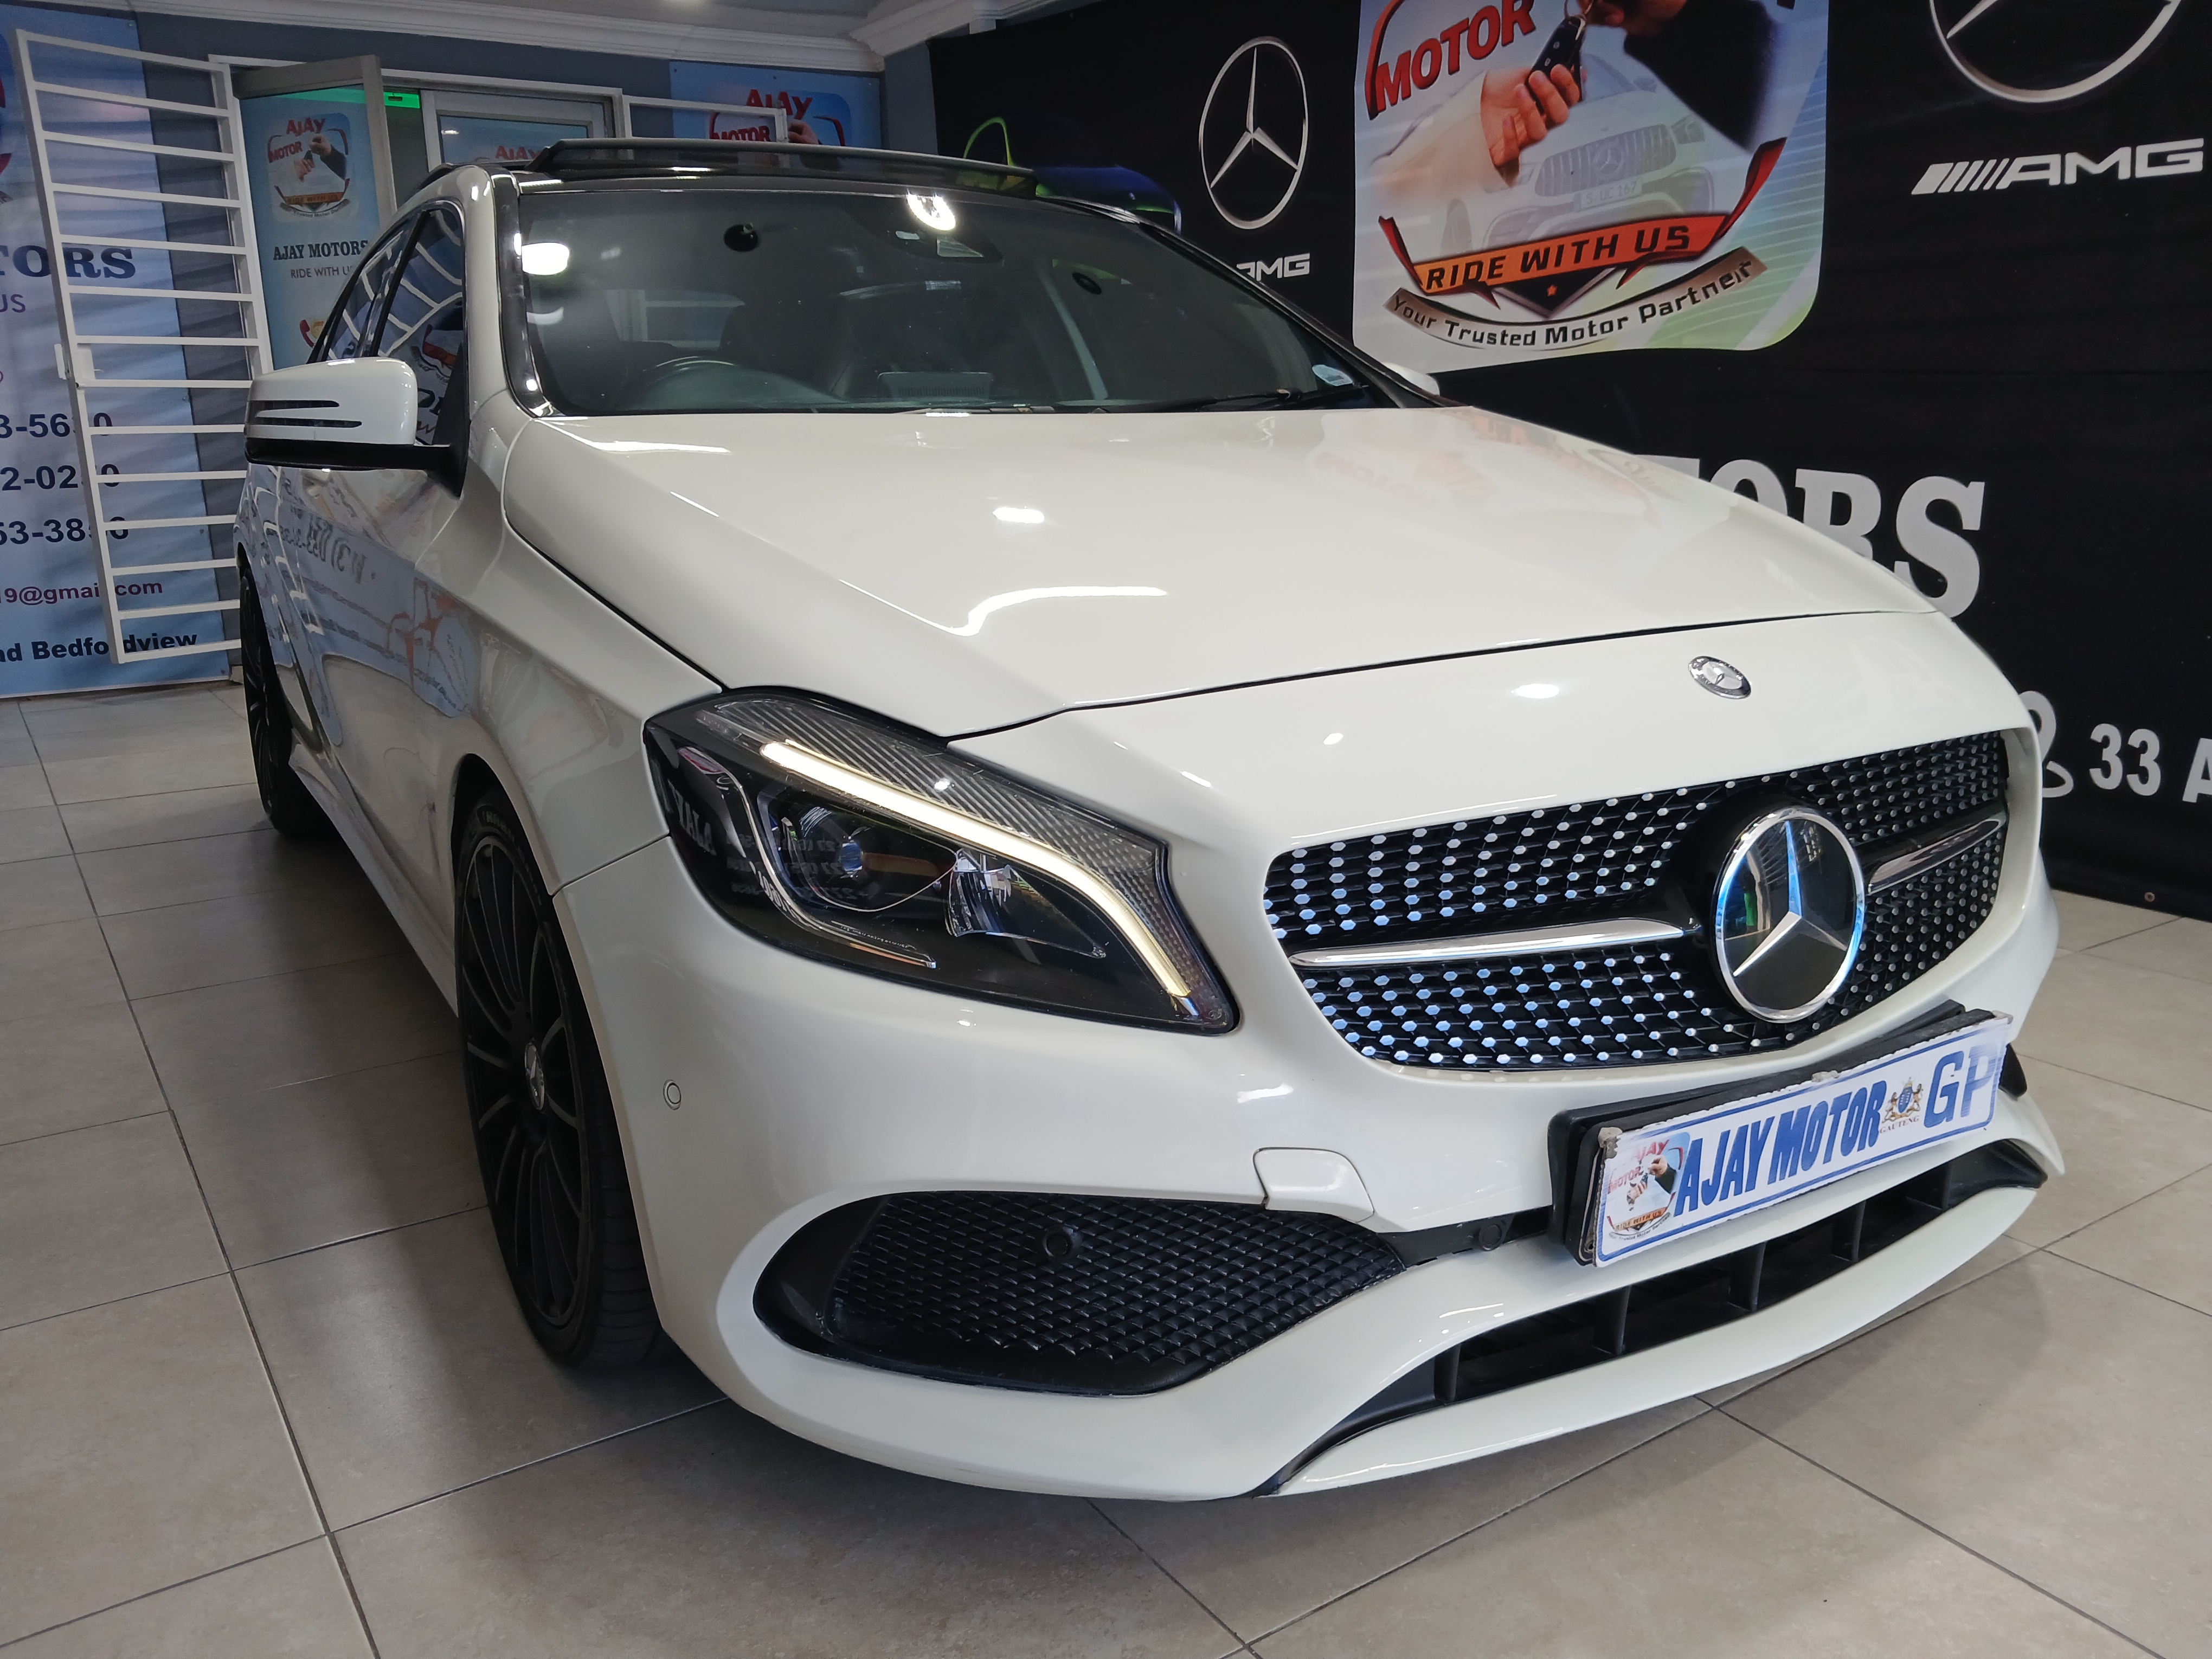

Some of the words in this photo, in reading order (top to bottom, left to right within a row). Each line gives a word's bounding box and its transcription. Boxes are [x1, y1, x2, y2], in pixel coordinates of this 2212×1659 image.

[1375, 0, 1536, 113] MOTOR
[287, 117, 326, 137] AJAY
[270, 142, 303, 163] MOTOR
[1995, 138, 2204, 189] AMG
[273, 245, 305, 260] AJAY
[1426, 255, 1506, 290] RIDE
[1520, 234, 1619, 273] WITH
[1635, 226, 1690, 253] US
[291, 268, 312, 279] RIDE
[313, 266, 339, 277] WITH
[342, 265, 351, 275] U
[1390, 294, 1437, 329] Your
[1444, 319, 1536, 346] Trusted
[1545, 316, 1629, 345] Motor
[0, 412, 113, 439] 3-560
[0, 464, 120, 491] 2-020
[31, 633, 198, 660] Bedfodview
[2089, 723, 2162, 796] 33
